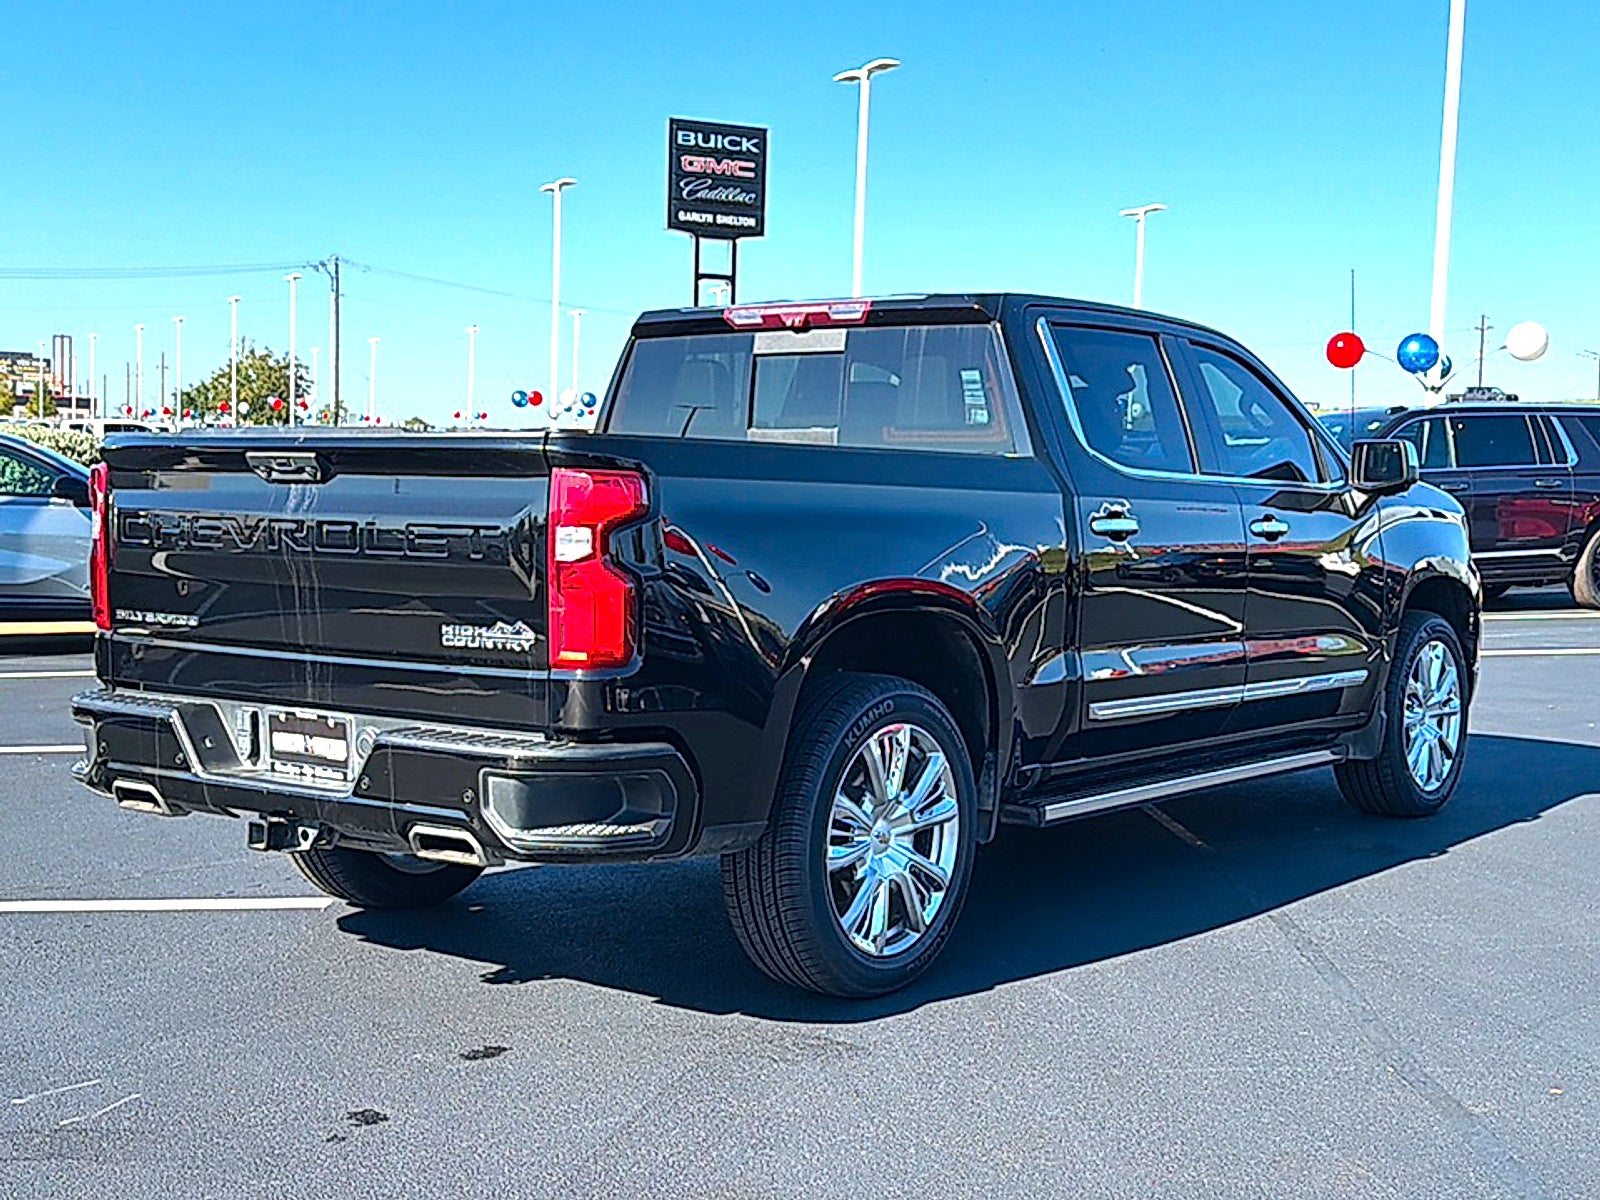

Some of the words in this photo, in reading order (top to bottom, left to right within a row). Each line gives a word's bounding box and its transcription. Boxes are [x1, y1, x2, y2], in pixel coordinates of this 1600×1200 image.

[677, 130, 760, 153] BUICK
[681, 155, 756, 178] GMC
[679, 177, 757, 204] Cadillac
[117, 511, 503, 560] CHEVROLET
[441, 624, 487, 636] HIGH
[441, 634, 535, 652] COUNTRY
[844, 699, 895, 748] KUMHO
